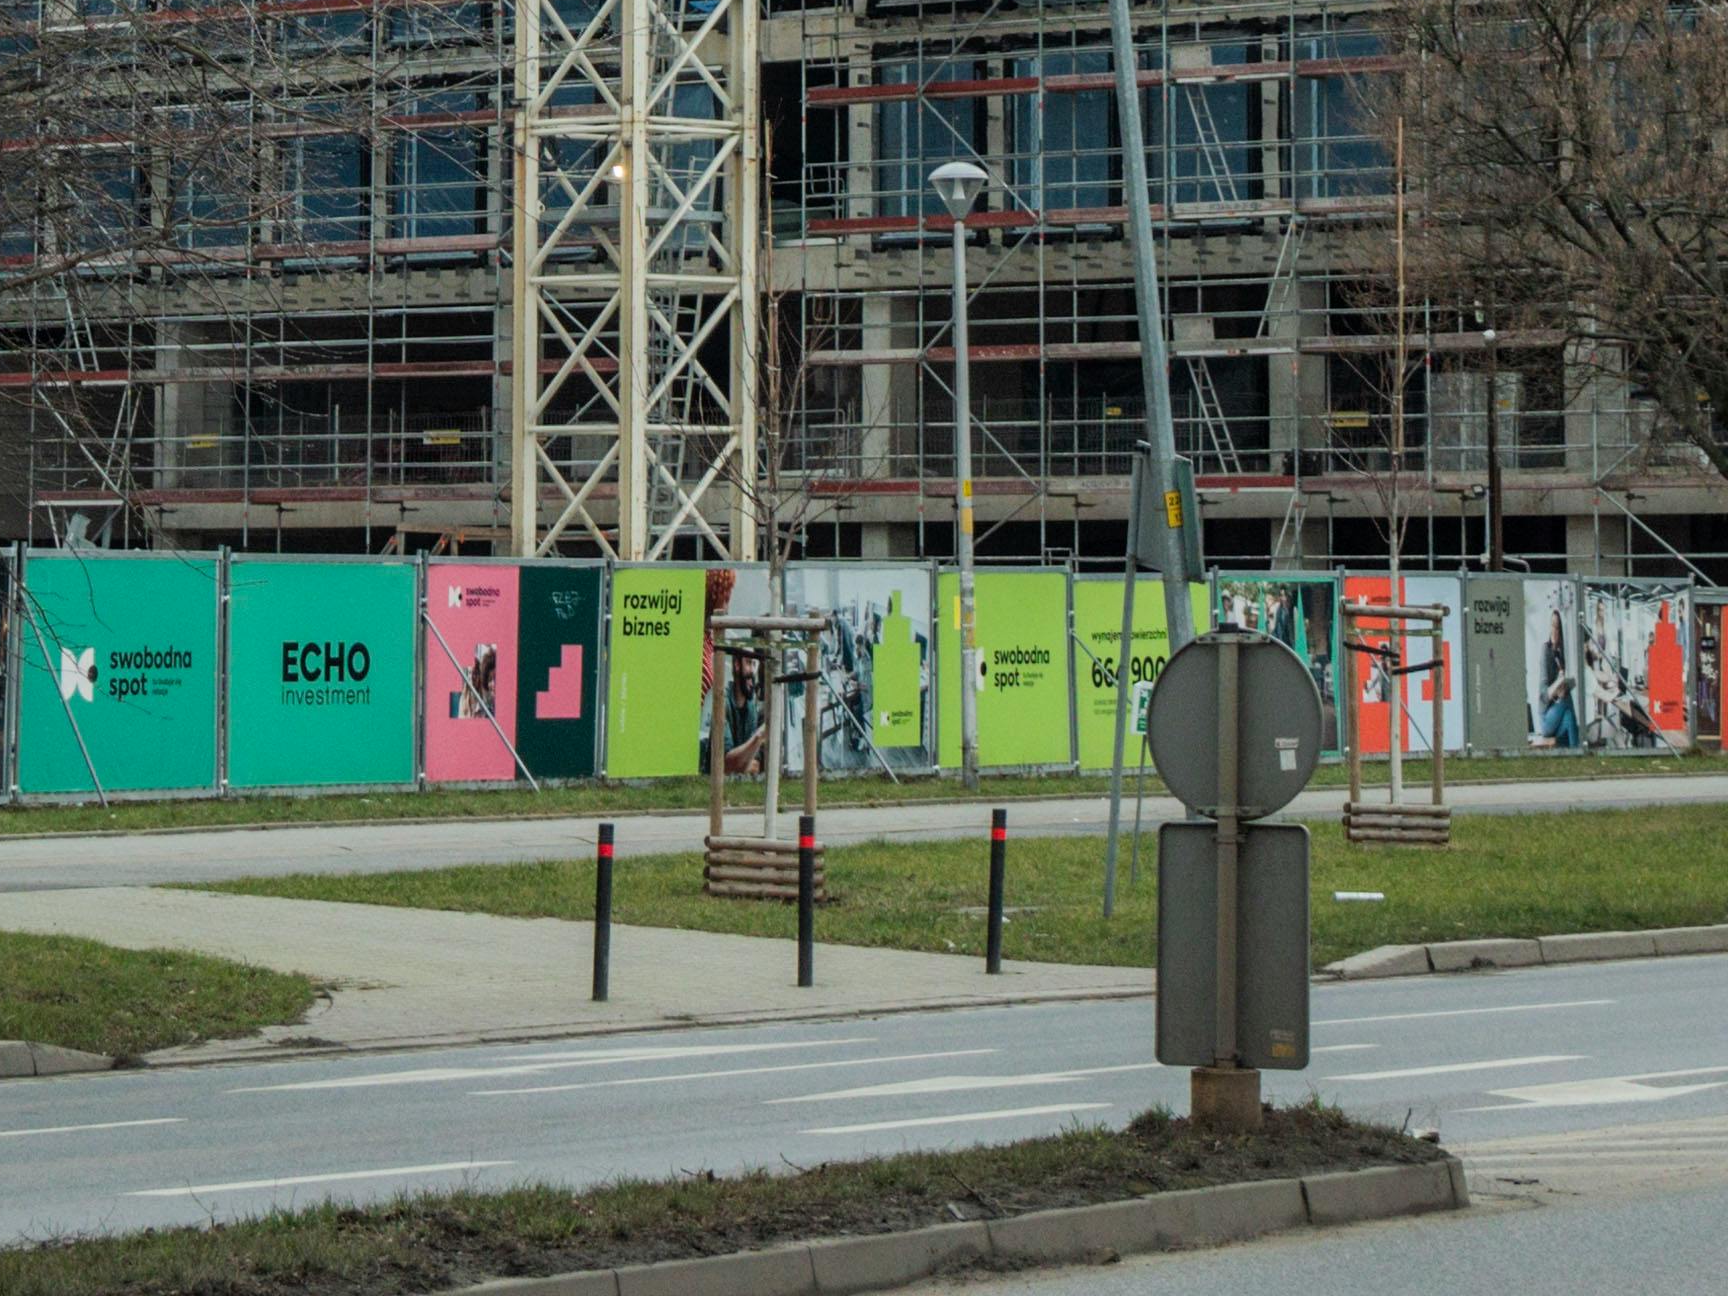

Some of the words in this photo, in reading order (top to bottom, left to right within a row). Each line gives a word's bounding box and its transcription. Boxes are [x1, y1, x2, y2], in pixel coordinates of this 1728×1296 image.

[623, 589, 683, 615] rozwijaj
[1474, 596, 1511, 617] rozwijaj
[622, 616, 671, 636] biznes
[1474, 618, 1504, 635] biznes
[109, 645, 192, 670] swobodna
[282, 641, 371, 683] ECHO
[993, 644, 1051, 665] swobodna
[109, 672, 148, 702] spot
[993, 667, 1021, 693] spot
[281, 685, 371, 706] investment
